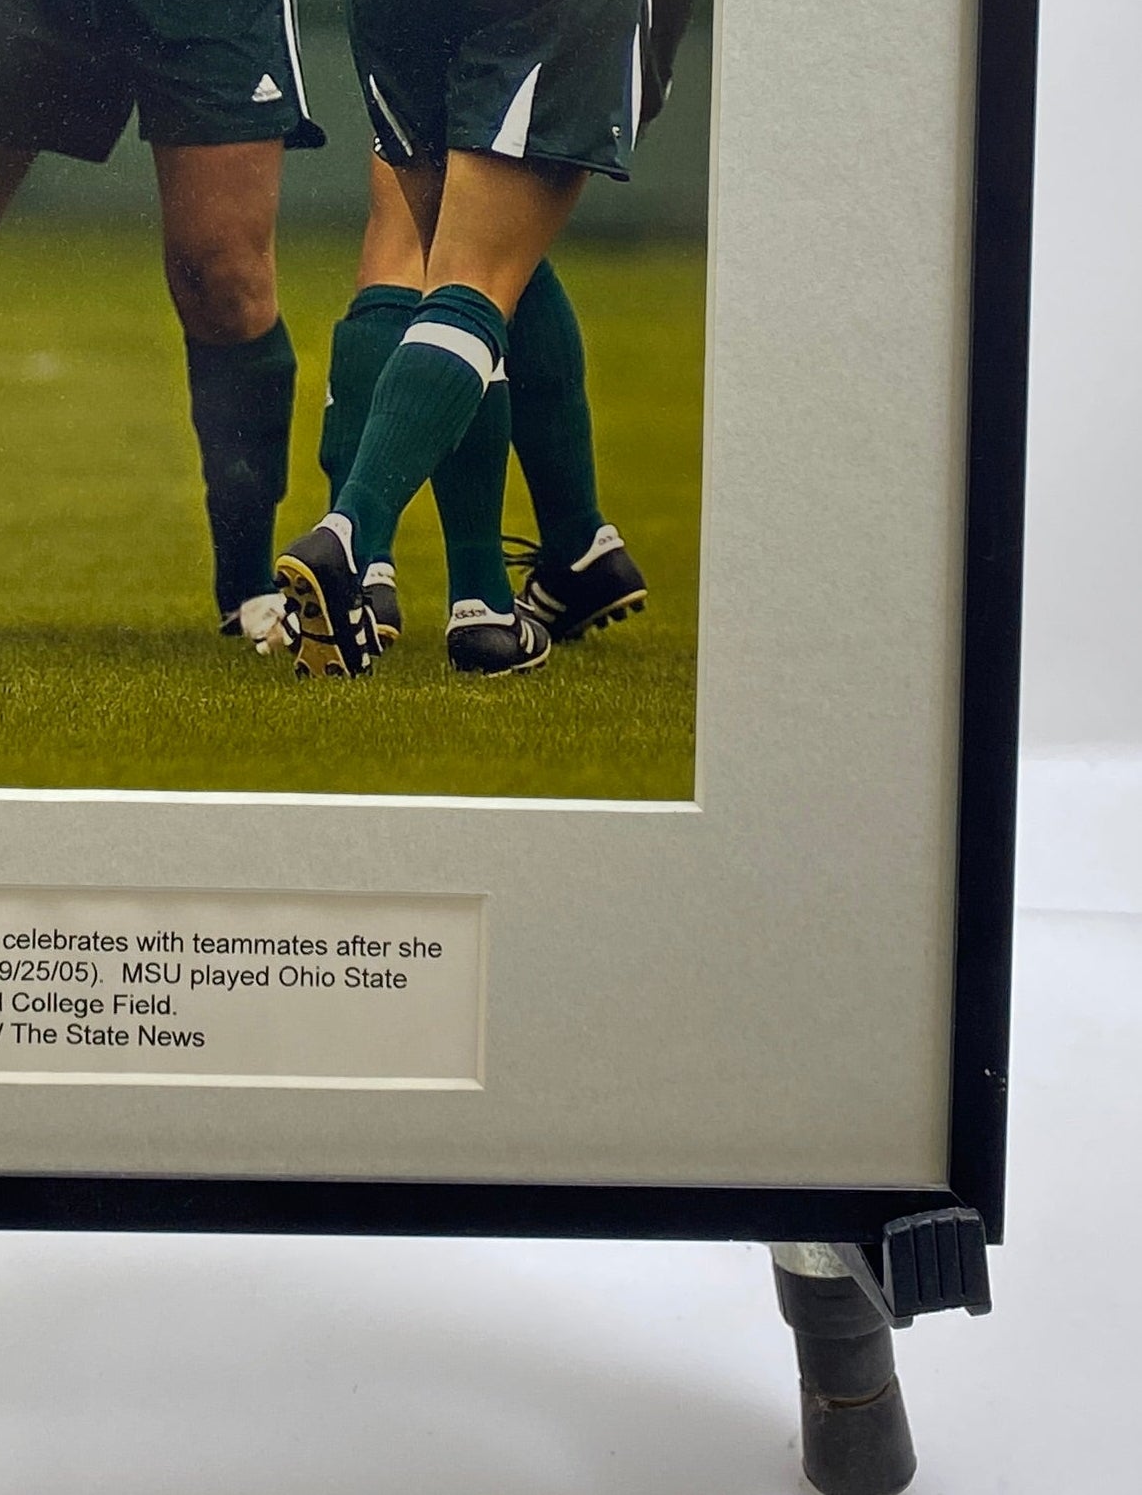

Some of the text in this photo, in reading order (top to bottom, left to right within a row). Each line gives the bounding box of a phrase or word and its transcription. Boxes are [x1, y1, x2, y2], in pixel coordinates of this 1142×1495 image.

[2, 927, 129, 953] celebrates
[135, 929, 184, 954] with
[191, 932, 329, 957] teammates
[336, 934, 392, 958] after
[398, 935, 443, 959] she
[122, 961, 182, 985] MSU
[190, 963, 270, 992] played
[278, 965, 336, 988] Ohio
[343, 966, 408, 990] State
[11, 991, 105, 1020] College
[112, 993, 178, 1016] Field.
[9, 1022, 58, 1045] The
[65, 1022, 130, 1047] State
[138, 1024, 206, 1048] News
